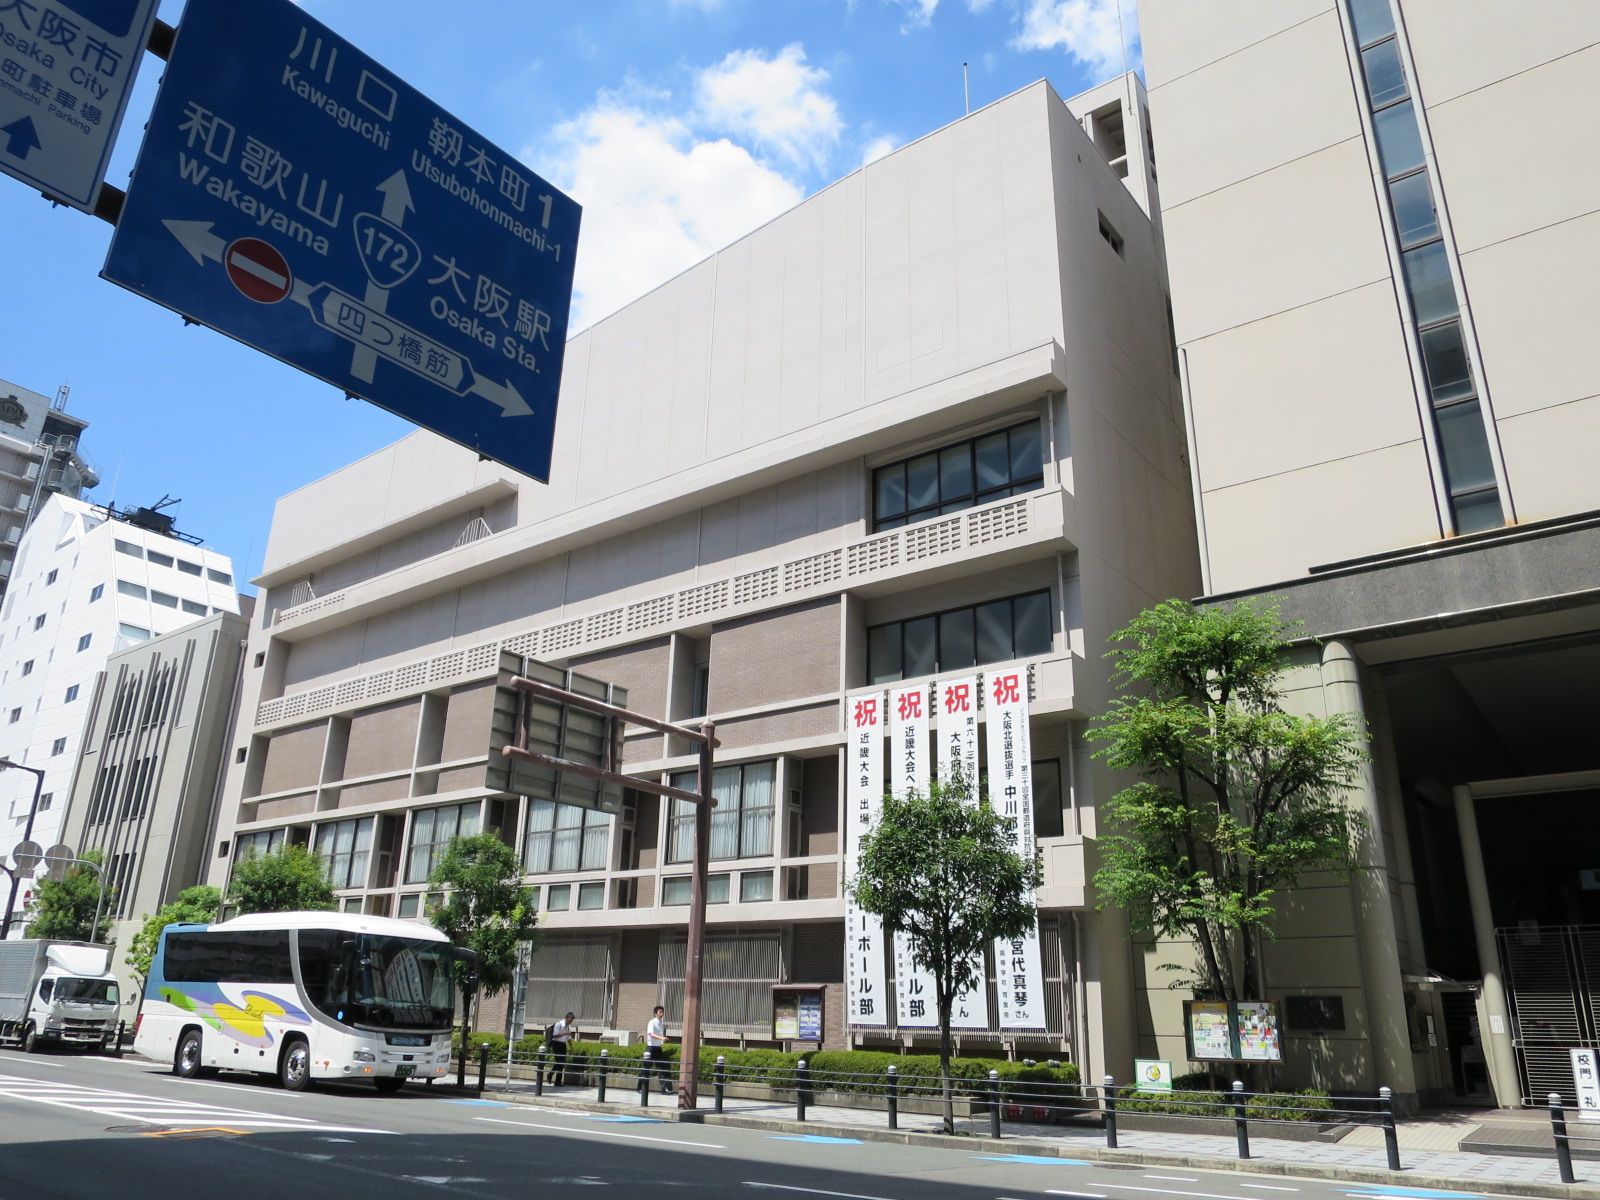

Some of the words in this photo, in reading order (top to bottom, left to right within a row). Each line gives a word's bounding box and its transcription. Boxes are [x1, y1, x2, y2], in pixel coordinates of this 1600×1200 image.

[0, 0, 122, 77] 大阪市
[69, 66, 109, 100] City
[288, 26, 398, 122] 川口
[47, 103, 91, 135] Parking
[281, 64, 391, 151] Kawaguchi
[177, 100, 344, 229] 和歌山
[179, 151, 329, 257] Wakayama
[411, 149, 561, 263] Utsubohonmachi-1
[364, 227, 408, 275] 172
[427, 254, 551, 352] 大阪駅
[430, 296, 496, 349] Osaka
[503, 335, 541, 374] Sta.
[337, 303, 451, 380] 四つ橋筋
[854, 699, 877, 728] 祝
[898, 691, 922, 721] 祝
[944, 684, 970, 714] 祝
[993, 674, 1020, 706] 祝
[859, 733, 870, 787] 近畿大会
[1003, 711, 1014, 780] 大阪北選抜選手
[859, 798, 870, 824] 出場
[1011, 941, 1028, 1007] 宮代真琴
[1577, 1054, 1597, 1108] 校門一礼
